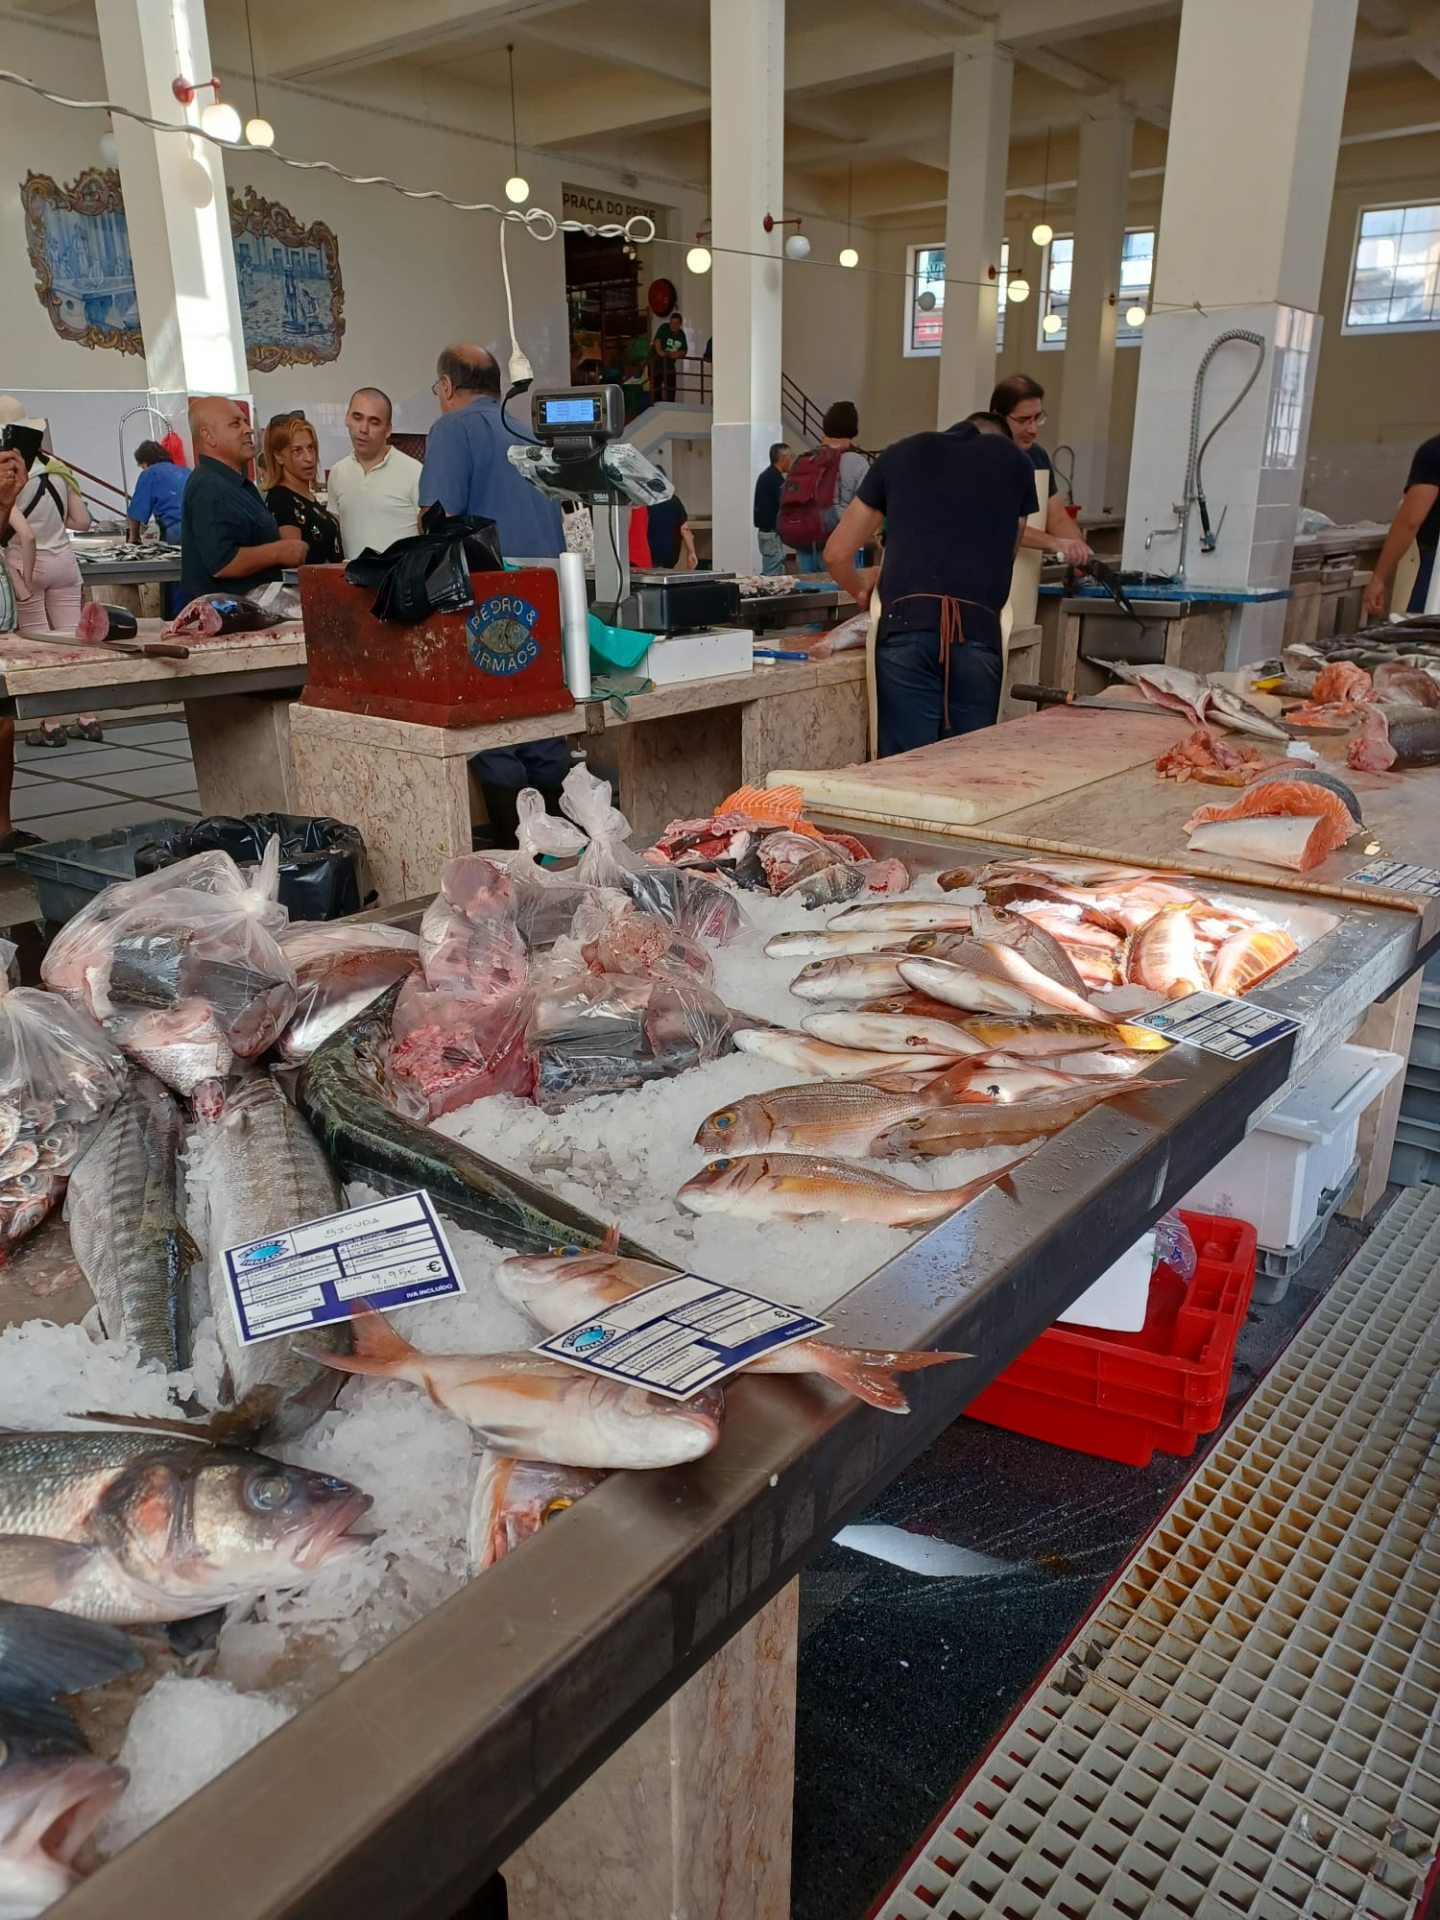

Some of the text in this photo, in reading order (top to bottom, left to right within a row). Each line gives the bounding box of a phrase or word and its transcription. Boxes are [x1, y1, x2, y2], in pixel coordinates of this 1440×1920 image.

[563, 193, 603, 214] PRAÇA
[607, 201, 622, 215] DO
[471, 597, 536, 630] PEDRO &
[474, 640, 537, 672] IRMÃOS
[426, 1261, 442, 1273] €
[406, 1283, 453, 1298] IVA INCLUÍDO
